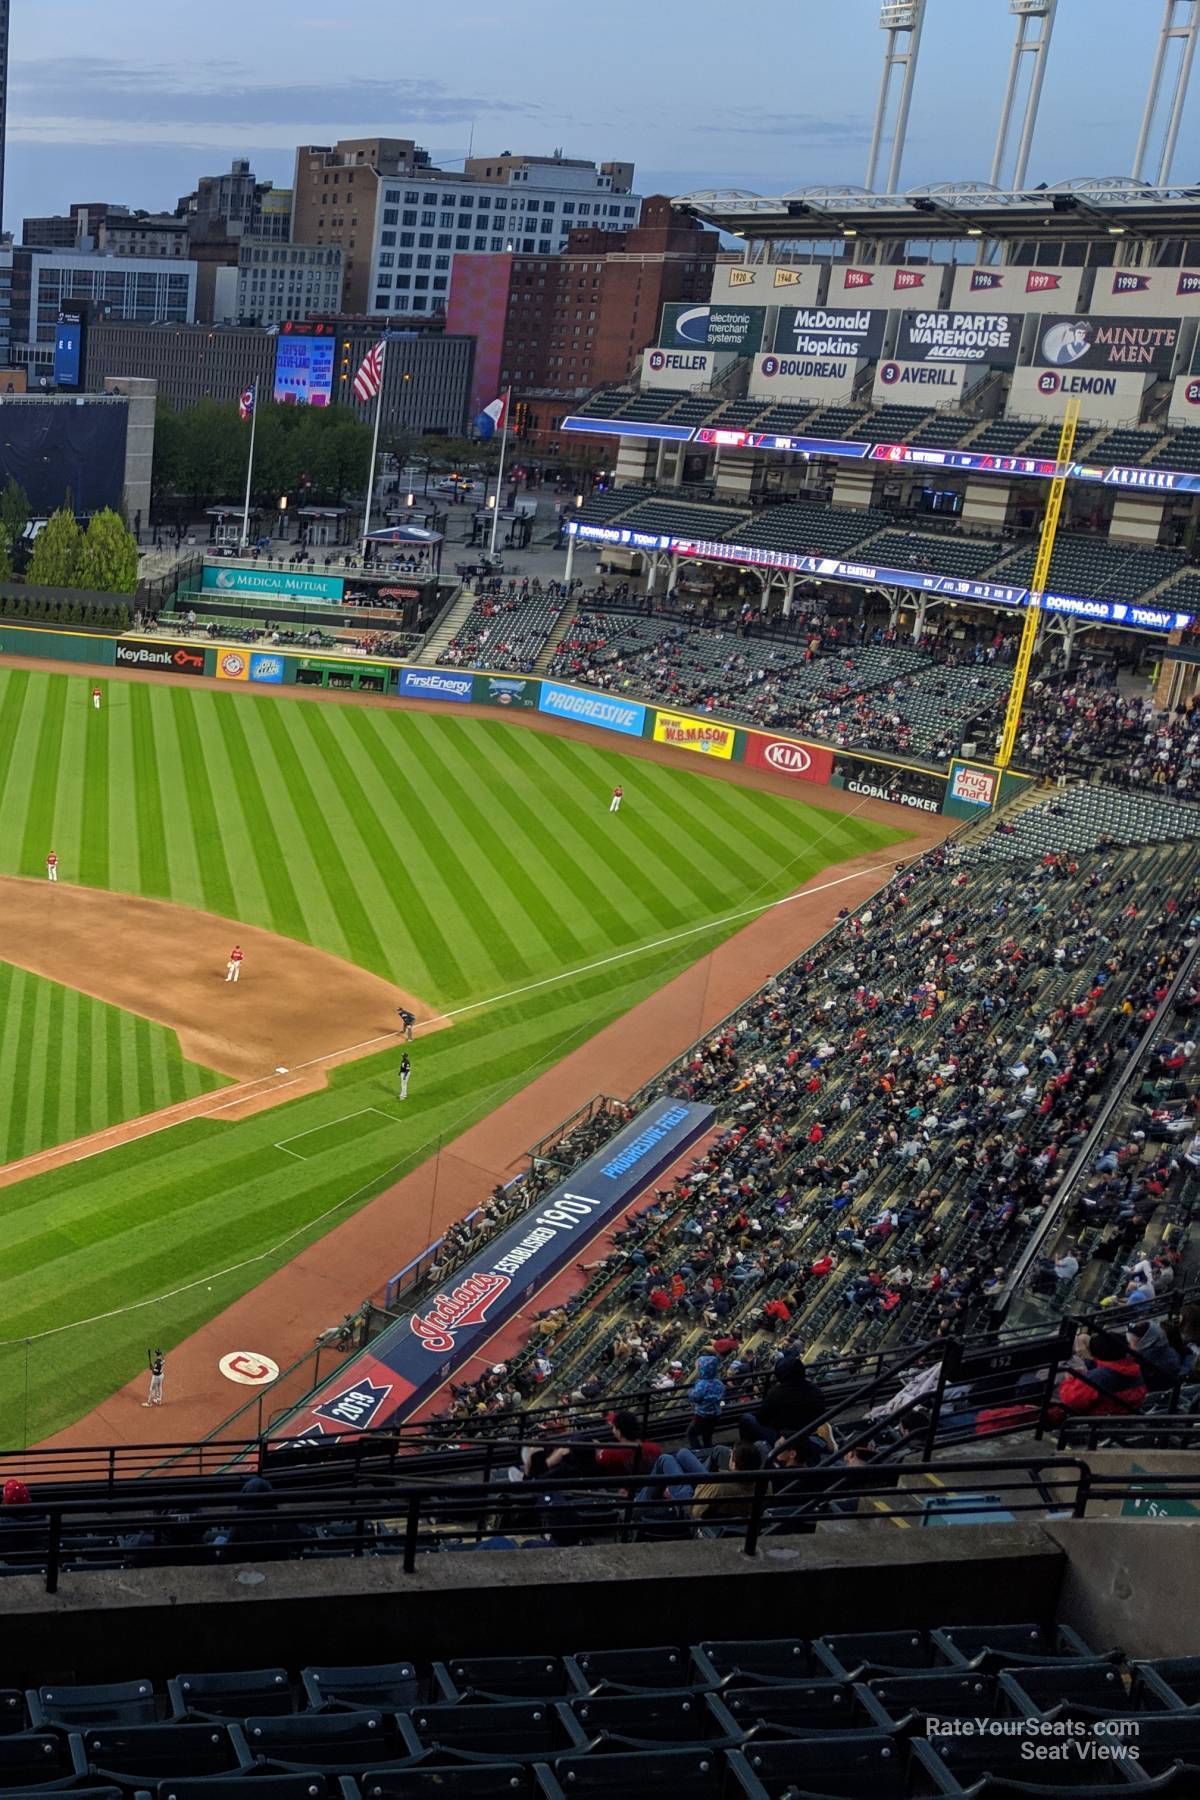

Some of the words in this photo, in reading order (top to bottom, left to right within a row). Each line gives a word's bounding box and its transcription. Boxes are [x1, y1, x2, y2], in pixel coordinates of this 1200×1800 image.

[732, 272, 747, 283] 1920
[898, 275, 915, 286] 1995
[974, 275, 992, 287] 1996
[1029, 276, 1049, 288] 1997
[1117, 277, 1138, 289] 1998
[710, 312, 750, 324] electronic
[794, 310, 871, 329] McDonald
[915, 313, 950, 329] CAR
[953, 315, 1009, 332] PARTS
[709, 323, 748, 333] merchant
[1095, 327, 1177, 346] MINUTE
[707, 333, 744, 344] systems
[797, 336, 859, 356] Hopkins
[909, 329, 1012, 348] WAREHOUSE
[666, 354, 707, 370] FELLER
[927, 347, 986, 360] ACDelco
[1108, 346, 1156, 363] MEN
[779, 361, 847, 379] BOUDREAU
[886, 368, 894, 379] 3
[900, 367, 957, 385] AVERILL
[1041, 378, 1055, 389] 21
[1060, 377, 1117, 396] LEMON
[1189, 386, 1200, 398] 2
[236, 574, 283, 588] MEDICAL
[286, 580, 328, 592] MUTUAL
[1046, 596, 1109, 617] DOWNLOAD
[1133, 609, 1171, 626] TODAY
[117, 646, 173, 665] KeyBank
[405, 673, 472, 696] FirstEnergy
[544, 690, 638, 727] PROGRESSIVE
[771, 746, 803, 768] KIA
[957, 768, 987, 791] drug
[848, 781, 891, 801] GLOBAL
[900, 793, 938, 812] POKER
[957, 785, 990, 802] mart
[600, 1125, 668, 1180] PROGRESSIVE
[656, 1106, 690, 1134] FIELD
[536, 1193, 601, 1231] 1901
[494, 1226, 557, 1277] ESTABLISHED
[410, 1271, 512, 1352] Indians
[228, 1356, 269, 1380] C
